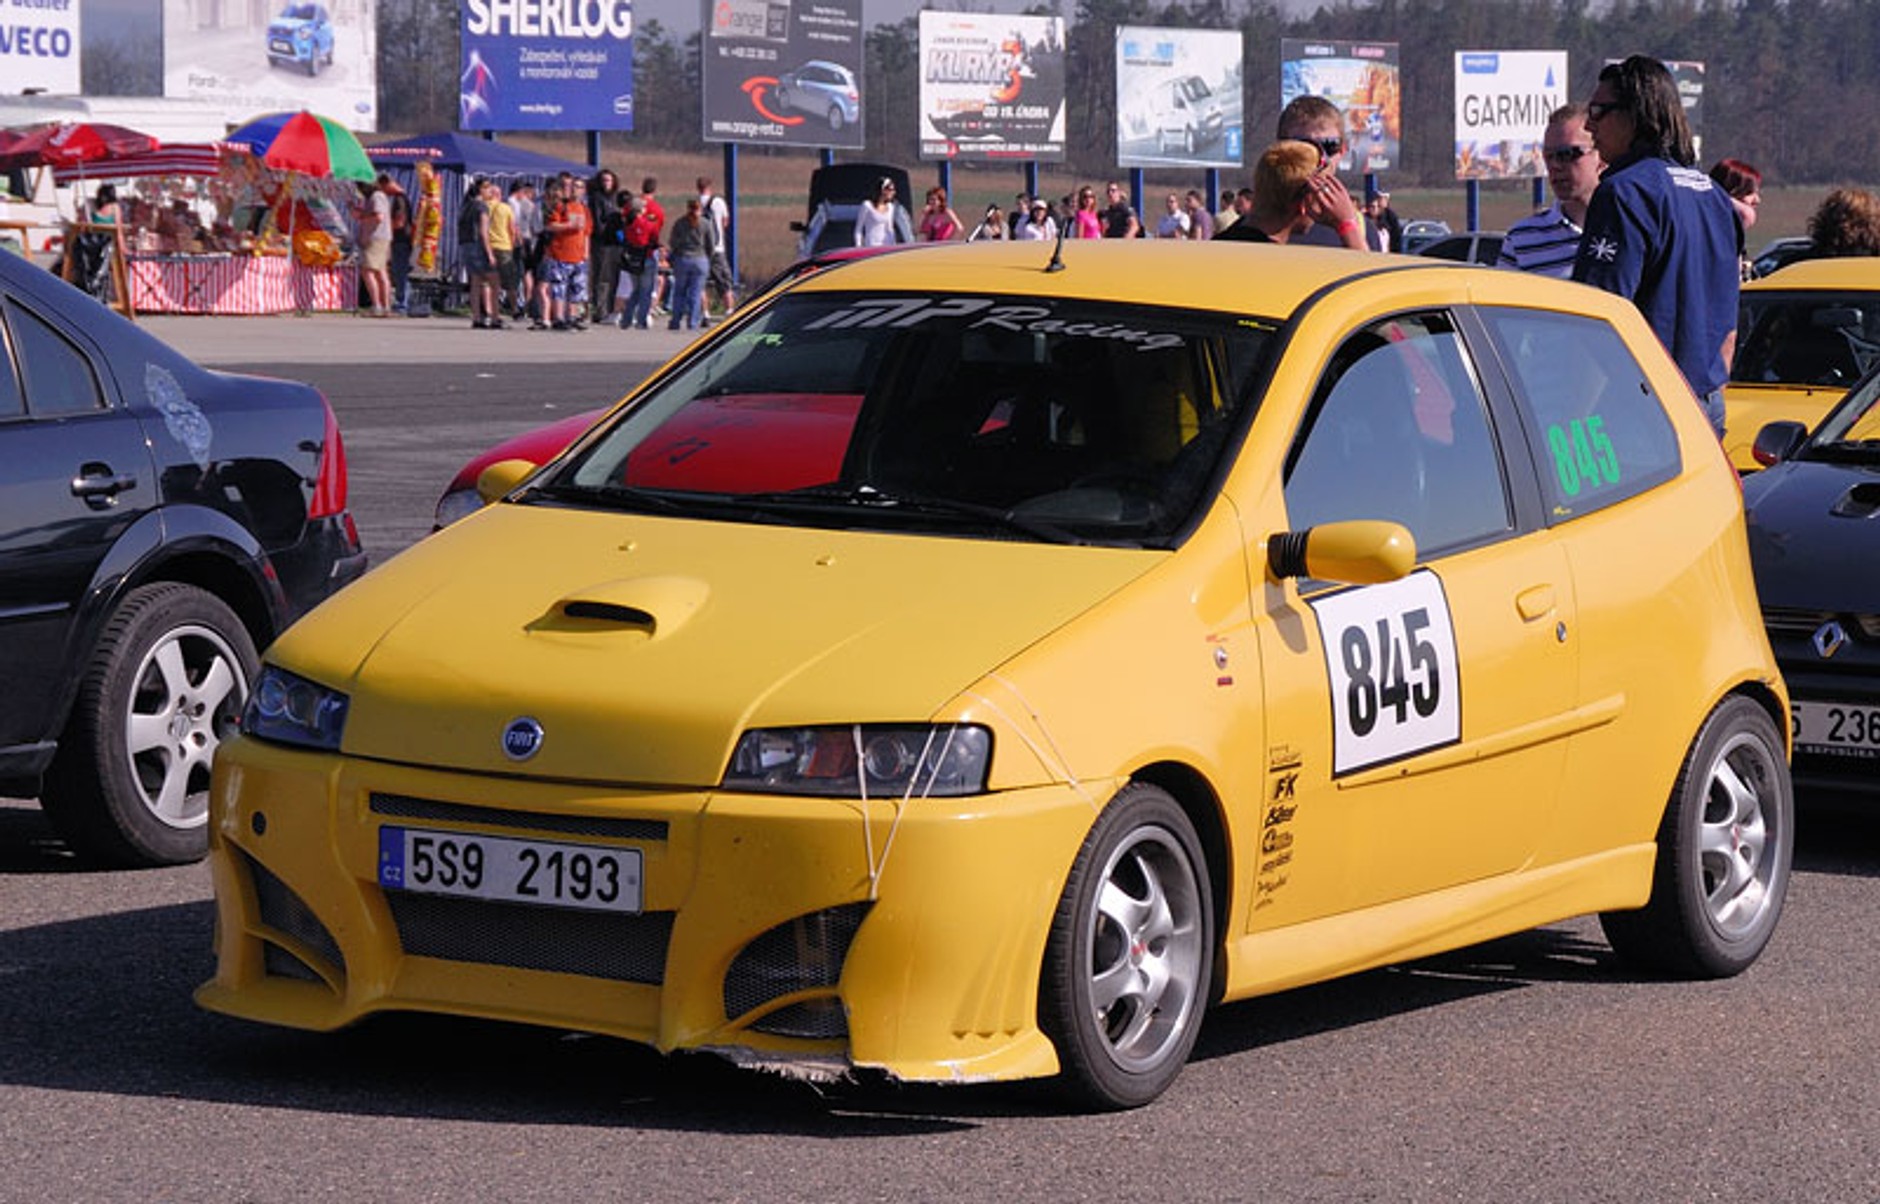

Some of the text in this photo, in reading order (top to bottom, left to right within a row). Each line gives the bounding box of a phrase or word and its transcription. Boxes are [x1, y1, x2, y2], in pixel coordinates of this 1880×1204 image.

[467, 0, 632, 38] SHERLOG
[1463, 93, 1557, 127] GARMIN
[968, 305, 1187, 351] Racing
[1547, 414, 1621, 497] 845
[1340, 606, 1441, 738] 845
[508, 731, 534, 747] FIAT
[383, 867, 401, 881] CZ
[412, 837, 620, 902] 5S9 2193
